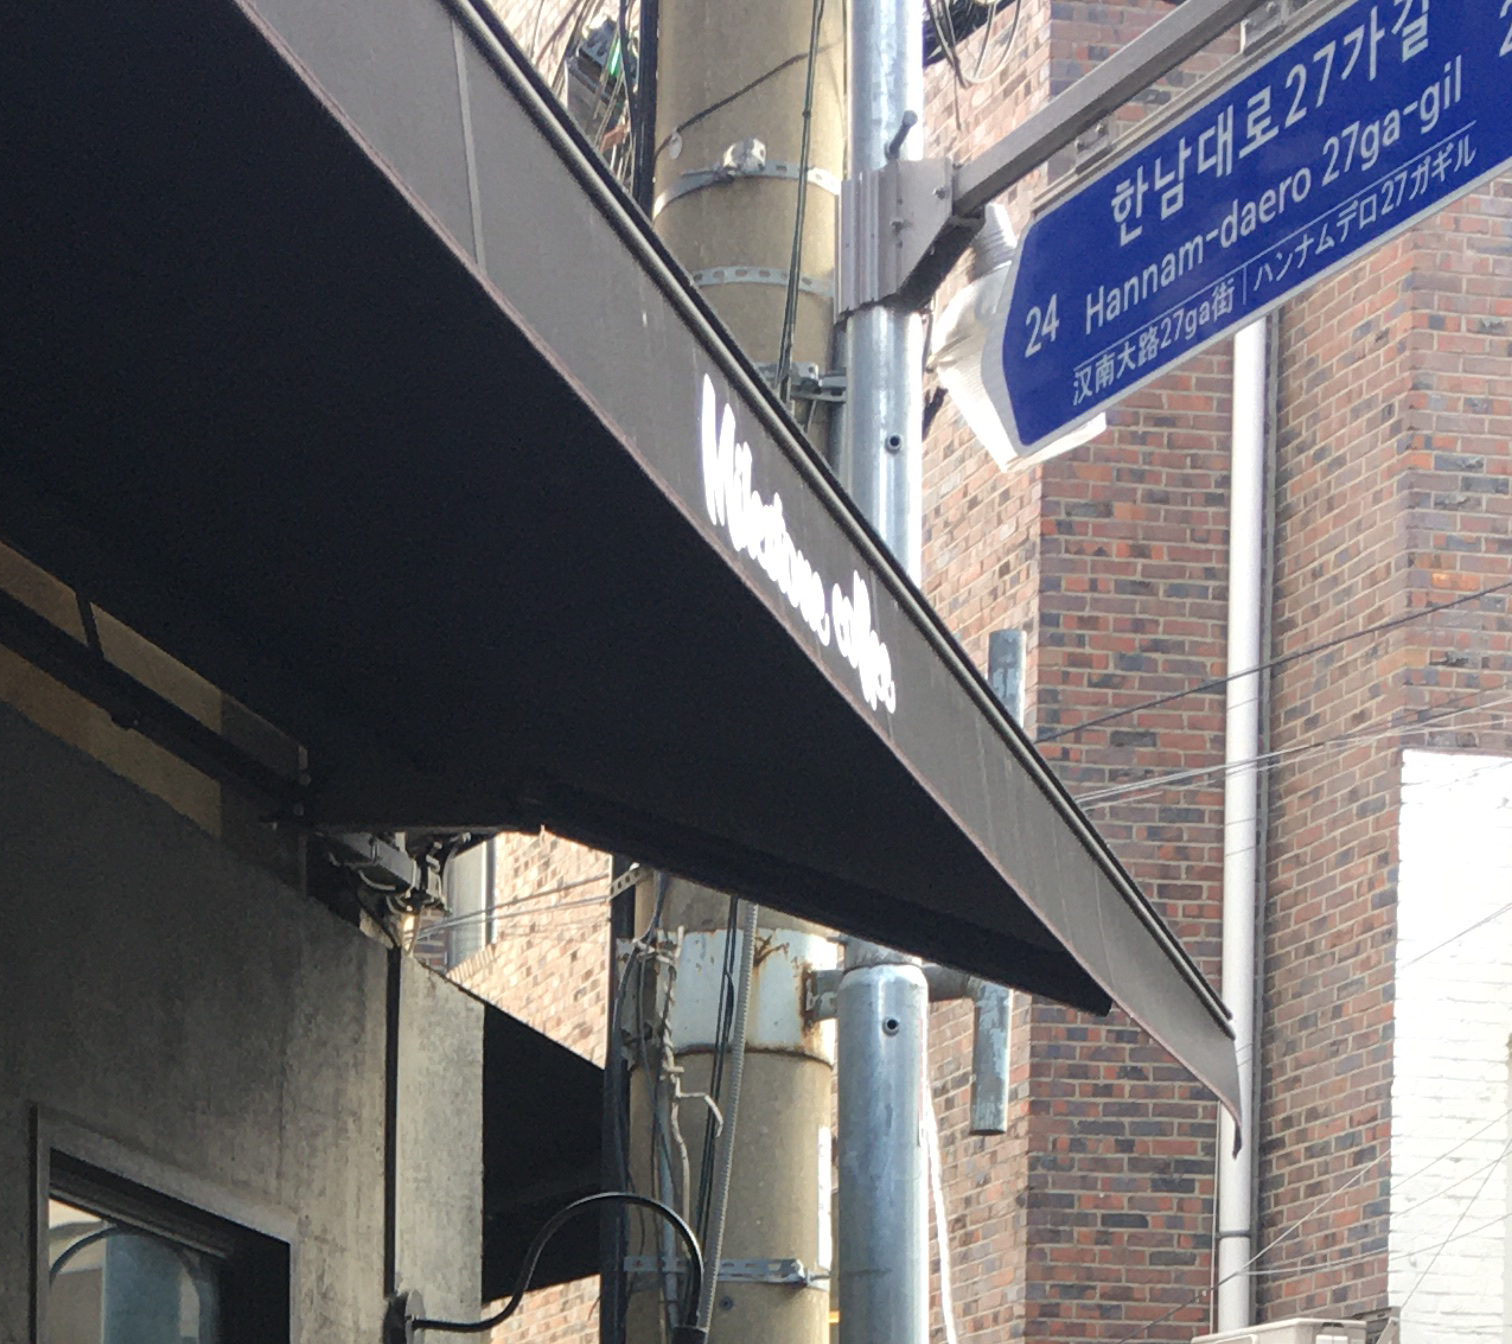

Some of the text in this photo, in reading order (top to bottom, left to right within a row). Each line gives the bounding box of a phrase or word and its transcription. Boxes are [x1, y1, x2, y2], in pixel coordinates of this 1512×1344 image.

[1085, 54, 1462, 336] Hannam-daero 27ga-gil
[1253, 134, 1477, 292] ハンナムデロ27ガギル
[1024, 293, 1060, 358] 24
[1072, 278, 1235, 406] 汉南大路27ga街
